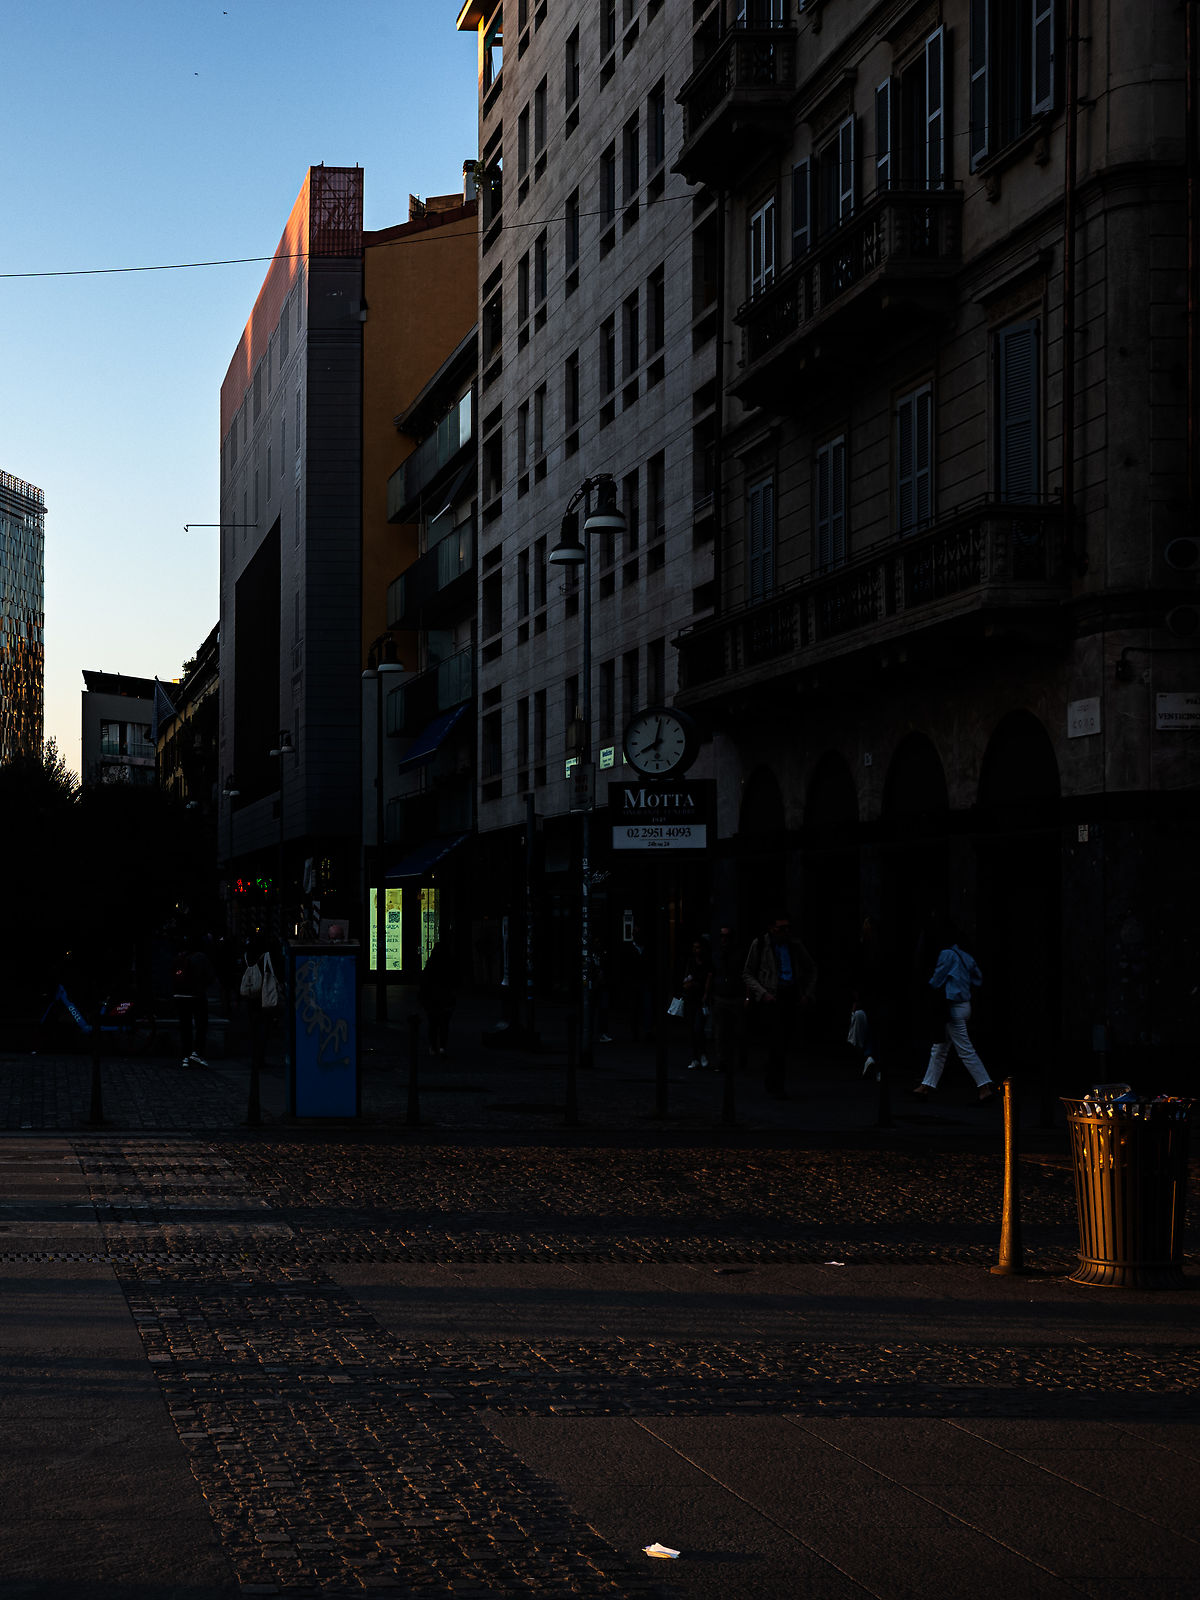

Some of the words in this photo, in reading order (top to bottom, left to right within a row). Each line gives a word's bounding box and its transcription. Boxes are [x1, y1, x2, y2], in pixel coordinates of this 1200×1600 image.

[623, 788, 696, 809] MOTTA
[627, 828, 640, 838] 02
[641, 828, 663, 838] 2951
[666, 827, 691, 837] 4093
